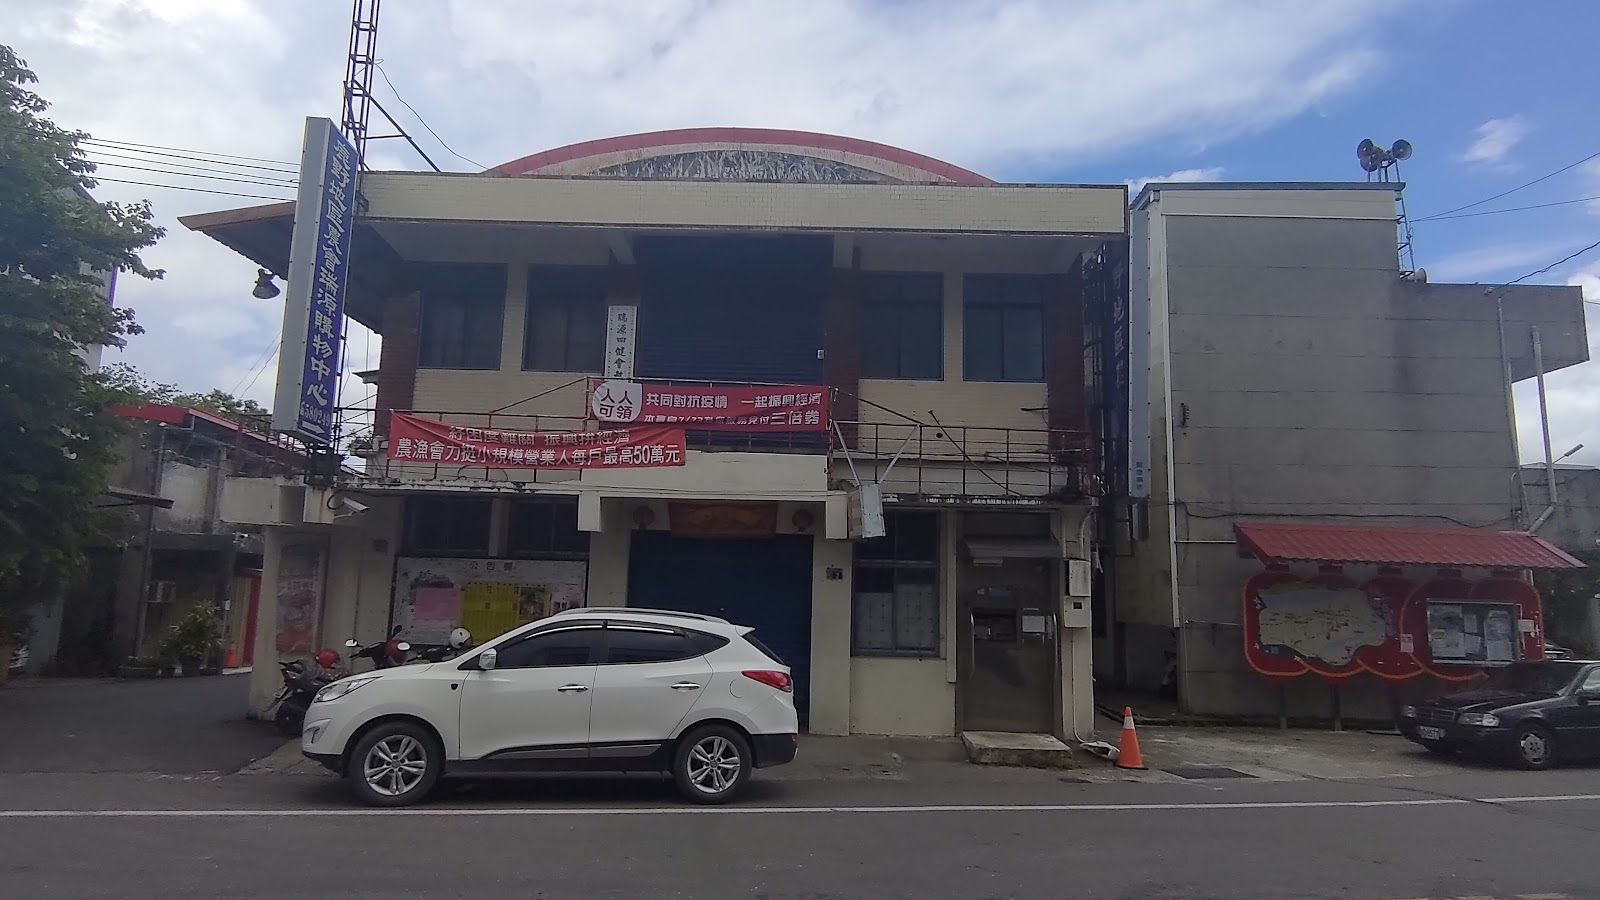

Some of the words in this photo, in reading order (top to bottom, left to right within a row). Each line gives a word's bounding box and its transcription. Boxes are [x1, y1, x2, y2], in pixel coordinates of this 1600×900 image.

[600, 388, 633, 405] 人人
[646, 393, 728, 408] 共同對抗疫情
[741, 392, 822, 408] 一起振興經濟
[599, 403, 633, 420] 可領
[448, 425, 536, 446] 紓困度難關
